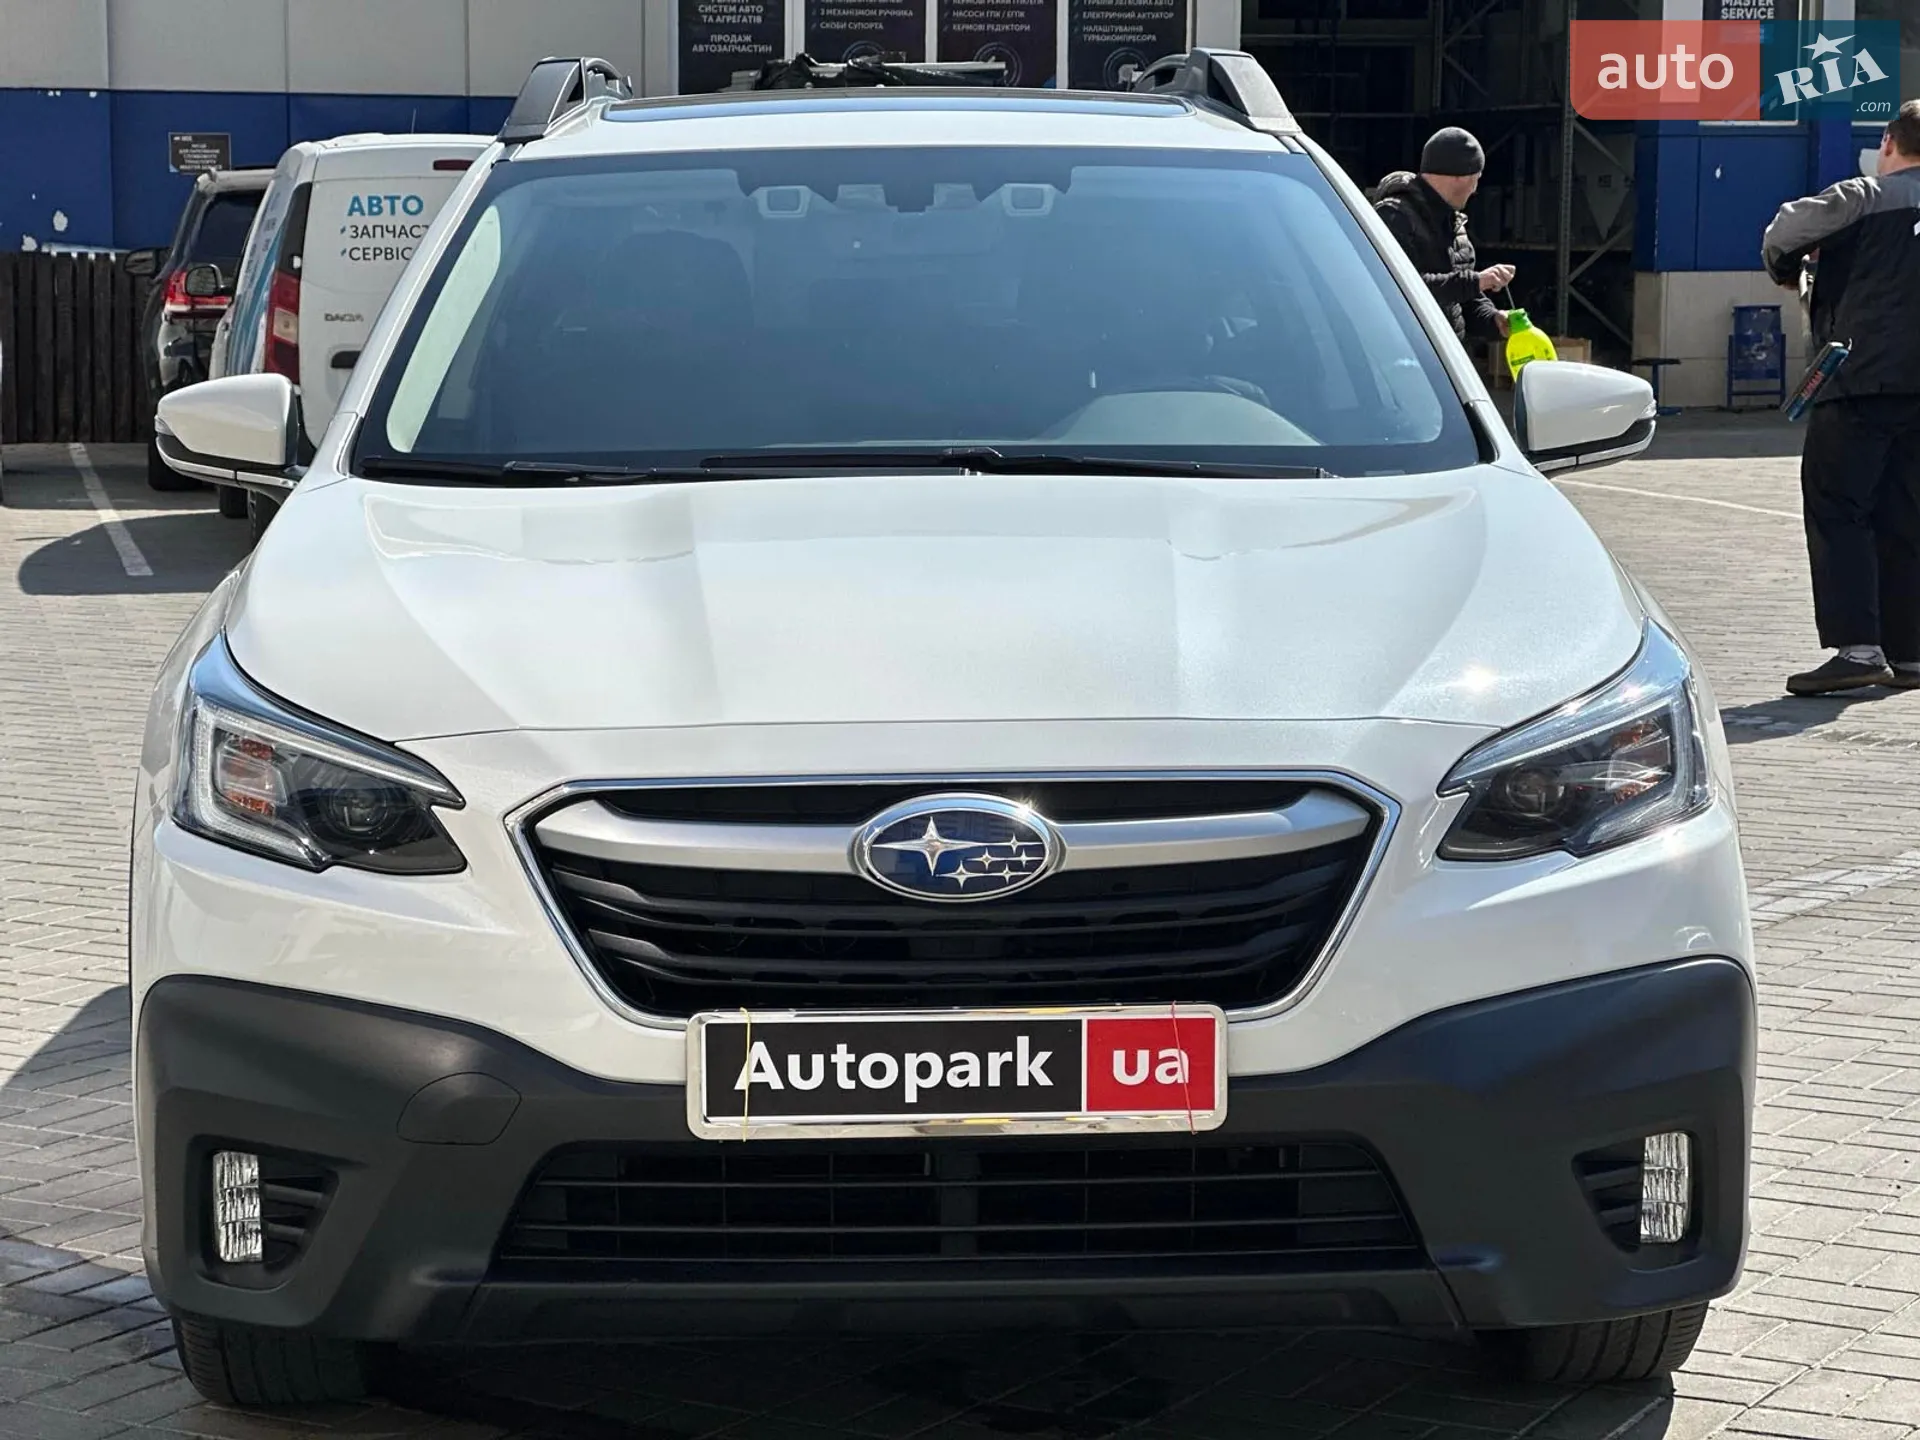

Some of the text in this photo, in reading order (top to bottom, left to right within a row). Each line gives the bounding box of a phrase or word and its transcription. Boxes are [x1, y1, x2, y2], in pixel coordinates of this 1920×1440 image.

[698, 4, 764, 13] СИСТЕМ АВТО
[1082, 11, 1175, 19] ЕЛЕКТРИЧНИЙ АКТУАТОР
[1721, 7, 1775, 20] SERVICE
[702, 15, 763, 23] ТА АГРЕГАТІВ
[710, 34, 752, 44] ПРОДАЖ
[692, 44, 773, 53] АВТОЗАПЧАСТИН
[347, 194, 424, 216] АВТО
[733, 1034, 1191, 1104] Autopark ua
